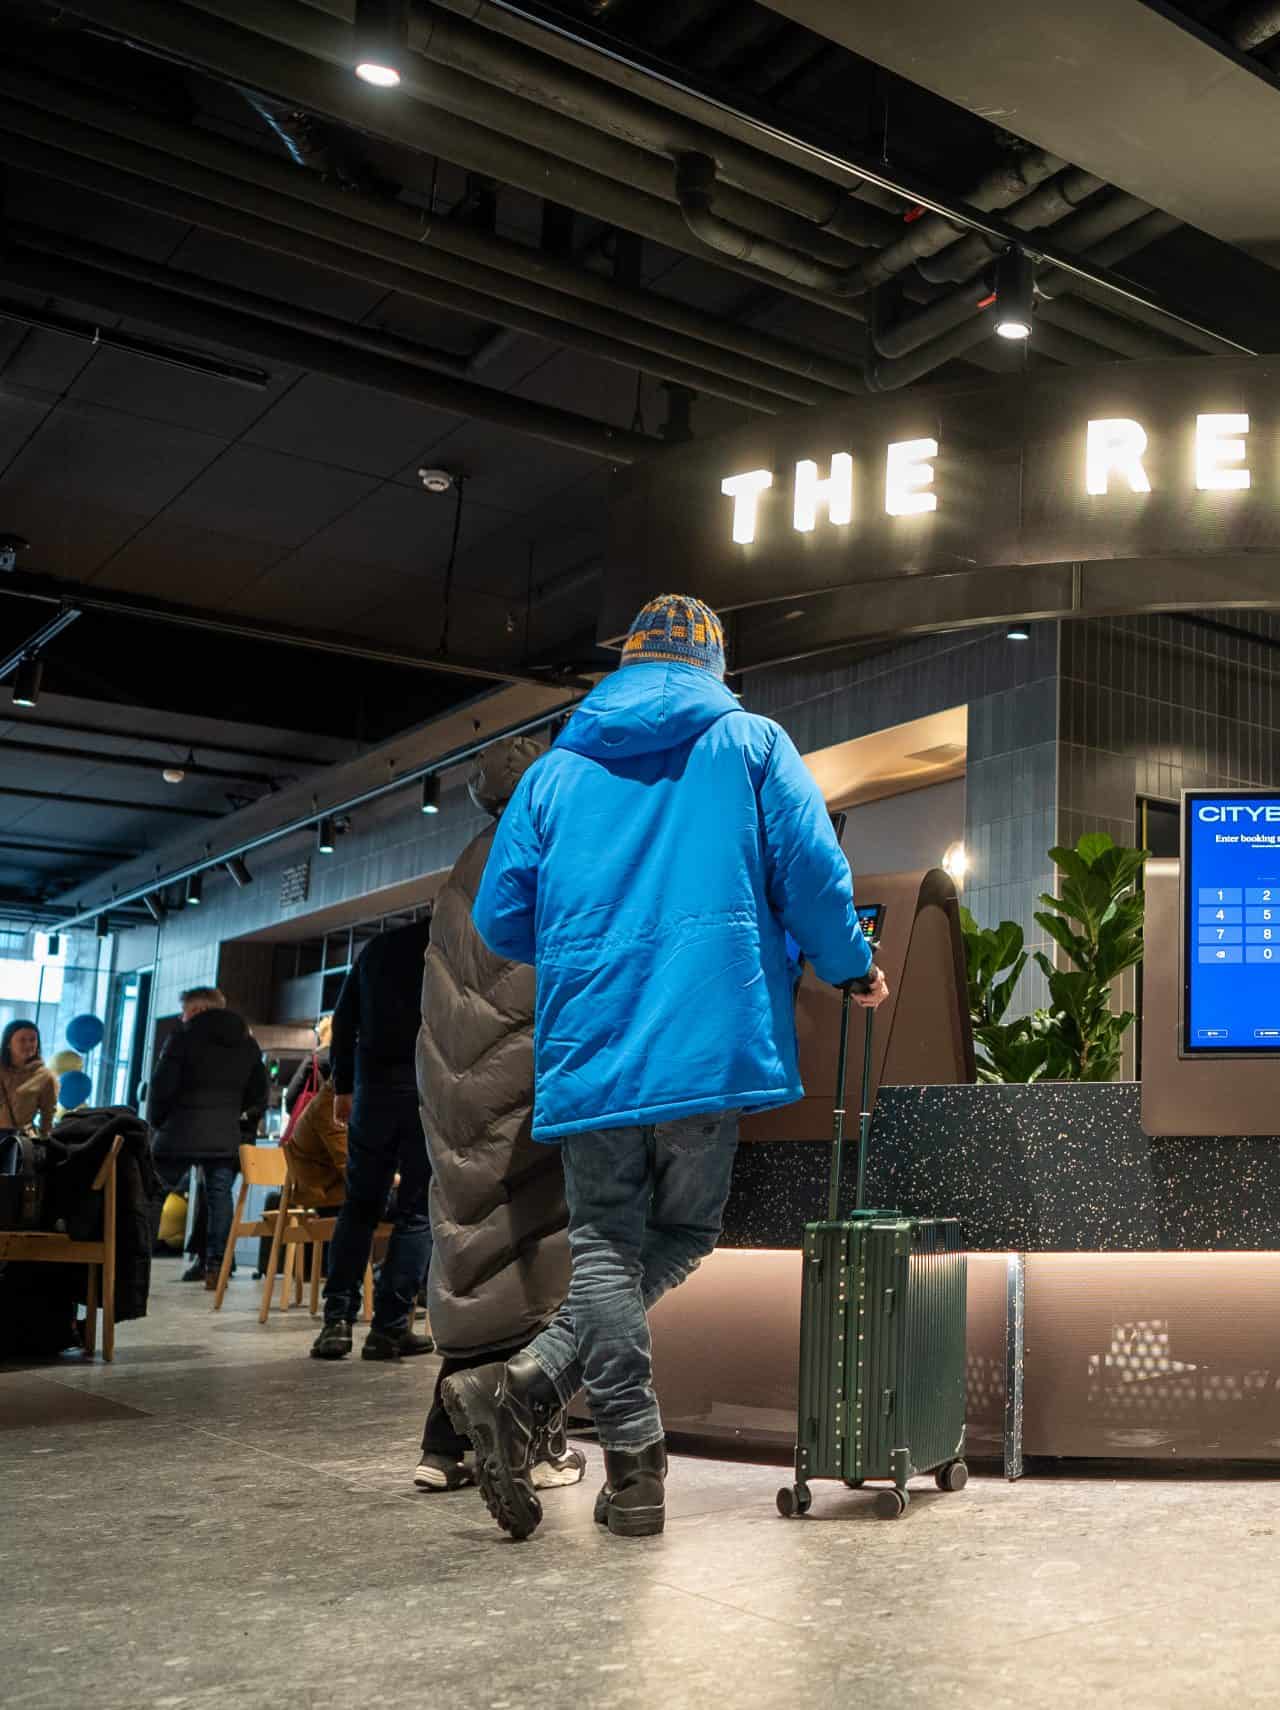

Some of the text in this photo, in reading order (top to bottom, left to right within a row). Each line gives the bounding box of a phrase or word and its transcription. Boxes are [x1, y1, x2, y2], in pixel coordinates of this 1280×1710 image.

[721, 437, 938, 544] THE
[1215, 833, 1239, 843] Enter
[1240, 832, 1276, 844] booking
[1216, 889, 1224, 901] 1
[1262, 889, 1272, 901] 2
[1216, 908, 1225, 921] 4
[1262, 908, 1272, 921] 5
[1216, 928, 1225, 940] 7
[1263, 928, 1272, 940] 8
[1263, 947, 1272, 960] 0
